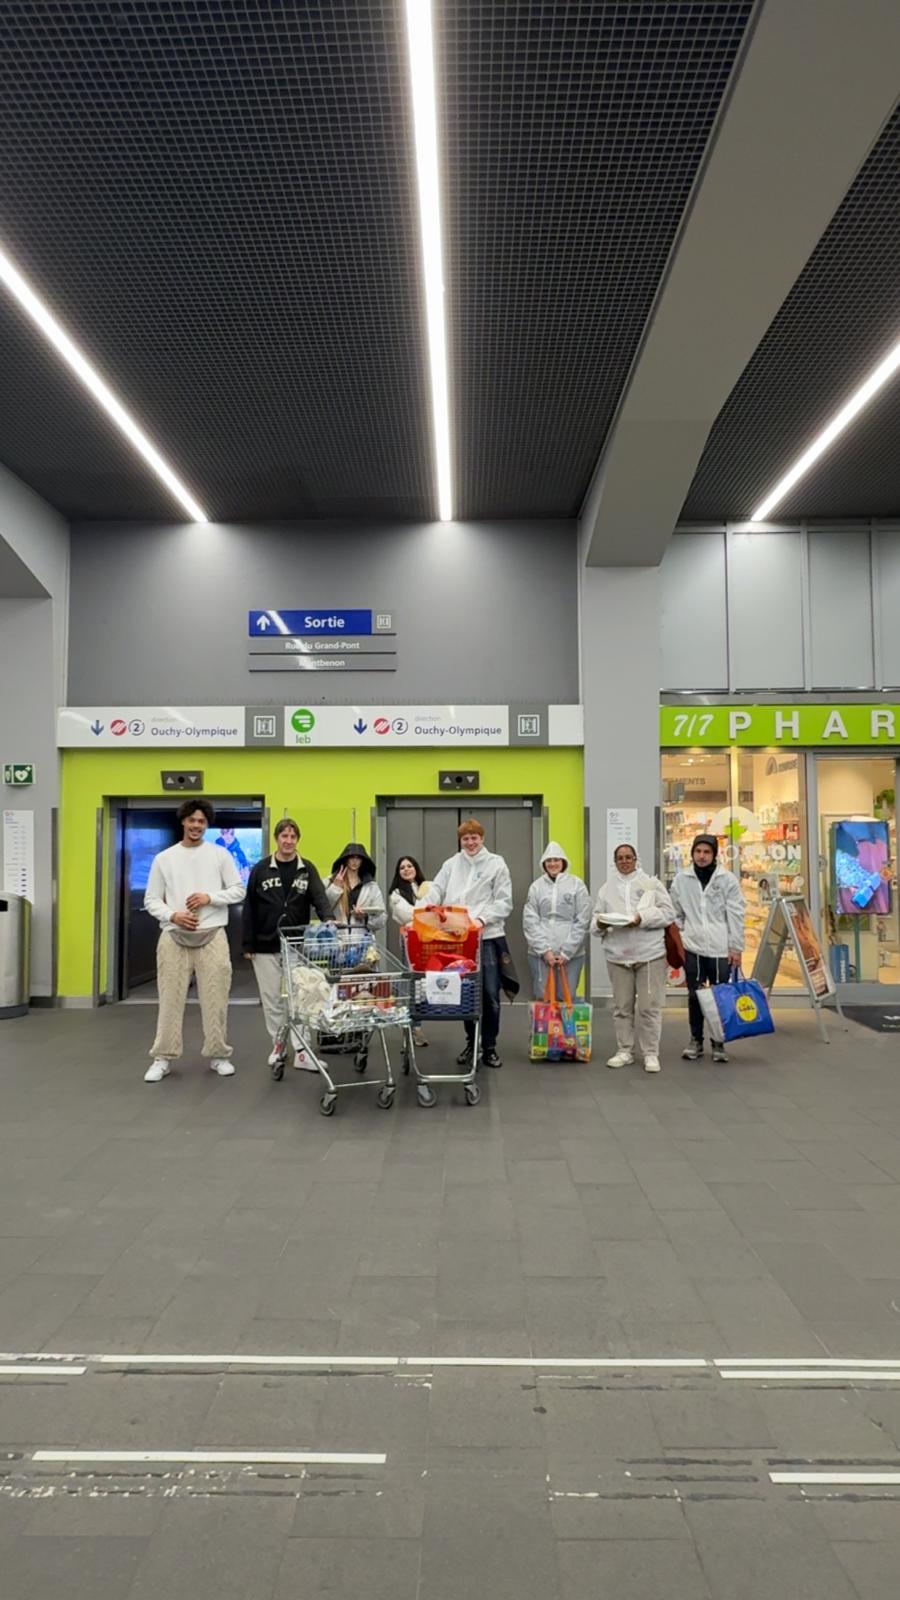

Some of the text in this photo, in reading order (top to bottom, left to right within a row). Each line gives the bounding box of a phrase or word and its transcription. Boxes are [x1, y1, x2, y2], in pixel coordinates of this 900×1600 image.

[304, 615, 345, 629] Sortie
[285, 641, 301, 650] Ru
[314, 641, 360, 650] Grand-Pont
[299, 658, 345, 667] Mntbenon
[414, 725, 502, 737] Ouchy-Olympique
[673, 713, 714, 738] 7/7
[151, 726, 238, 738] Ouchy-Olympique
[295, 734, 311, 744] leb
